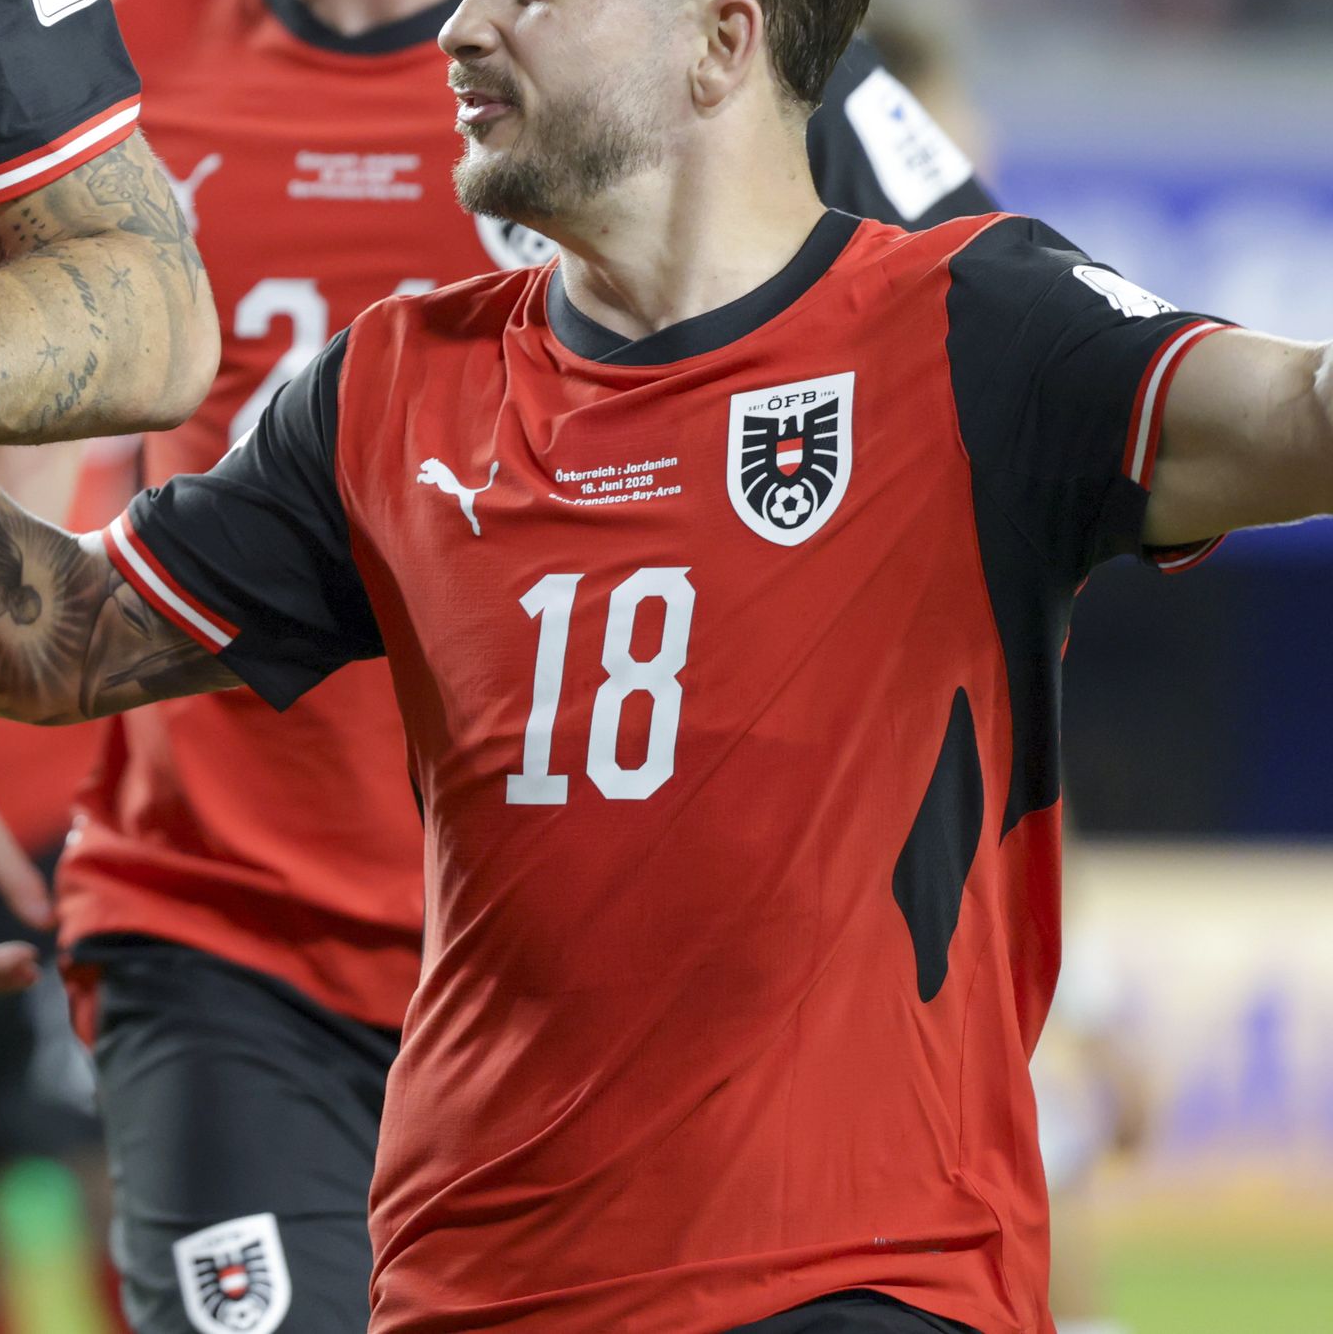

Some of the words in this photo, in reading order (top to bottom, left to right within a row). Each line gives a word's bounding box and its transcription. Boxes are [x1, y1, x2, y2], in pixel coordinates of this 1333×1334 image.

[767, 391, 817, 411] ÖFB
[555, 466, 616, 483] Österreich
[623, 457, 678, 474] Jordanien
[580, 483, 596, 494] 16.
[598, 479, 623, 492] Juni
[625, 474, 654, 489] 2026
[506, 567, 696, 804] 18
